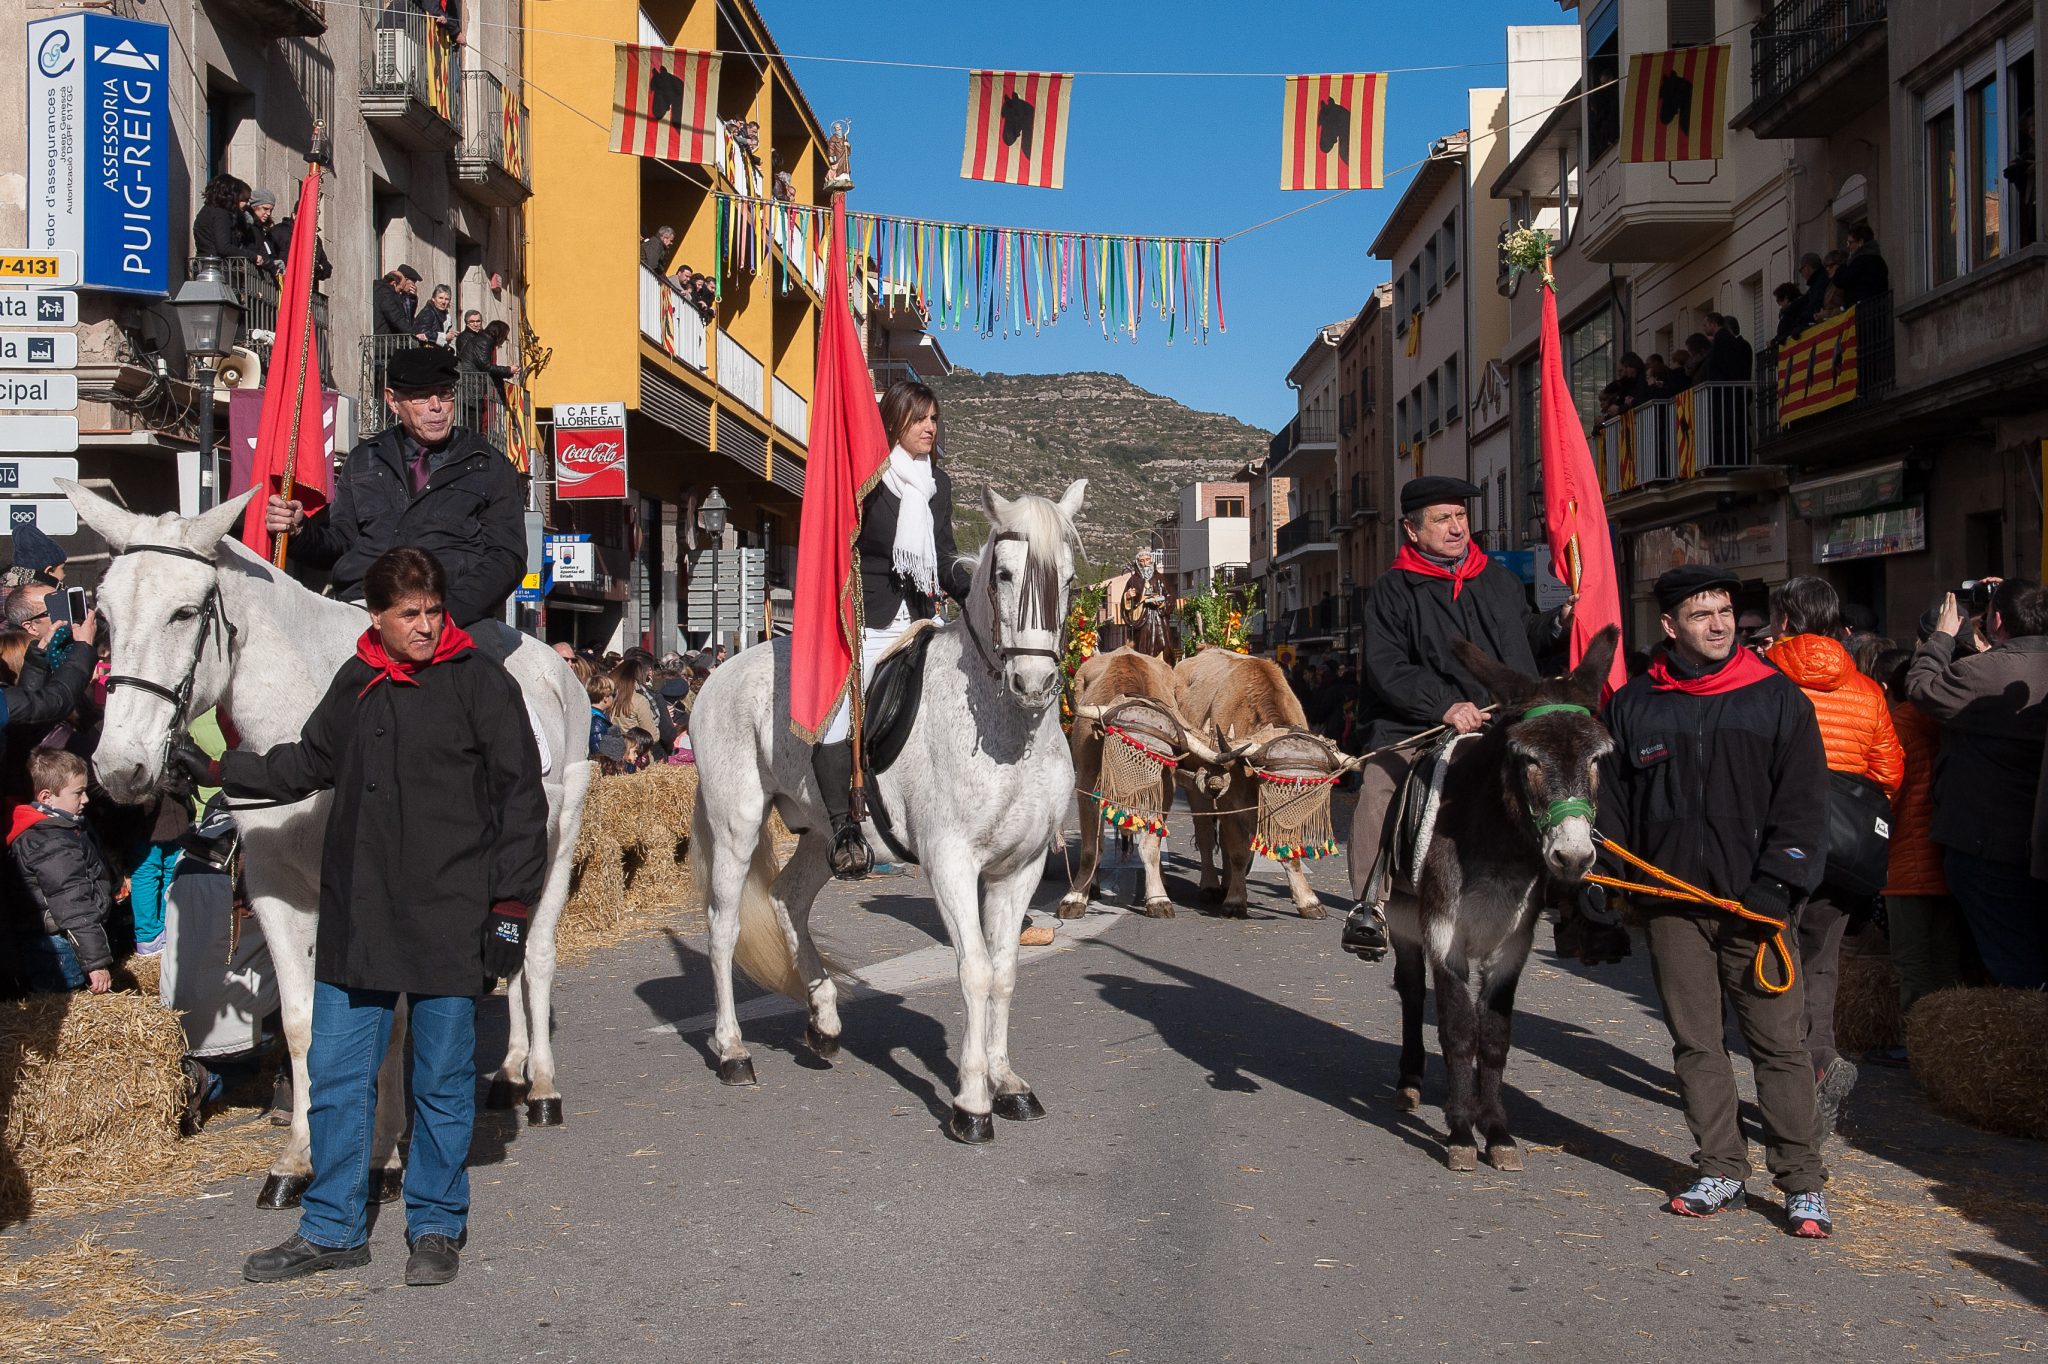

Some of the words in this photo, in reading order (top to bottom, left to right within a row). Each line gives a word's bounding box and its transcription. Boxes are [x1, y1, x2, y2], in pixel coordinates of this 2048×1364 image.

[66, 85, 74, 121] 017GC
[46, 88, 58, 208] d'assegurances
[59, 133, 68, 163] Josep
[103, 78, 119, 193] ASSESSORIA
[123, 80, 152, 274] PUIG-REIG
[46, 213, 56, 250] edor
[0, 259, 57, 275] -4131
[0, 296, 27, 317] ta
[555, 416, 621, 427] LLOBREGAT
[567, 406, 608, 417] CAFE
[561, 442, 620, 464] Coca-Cola
